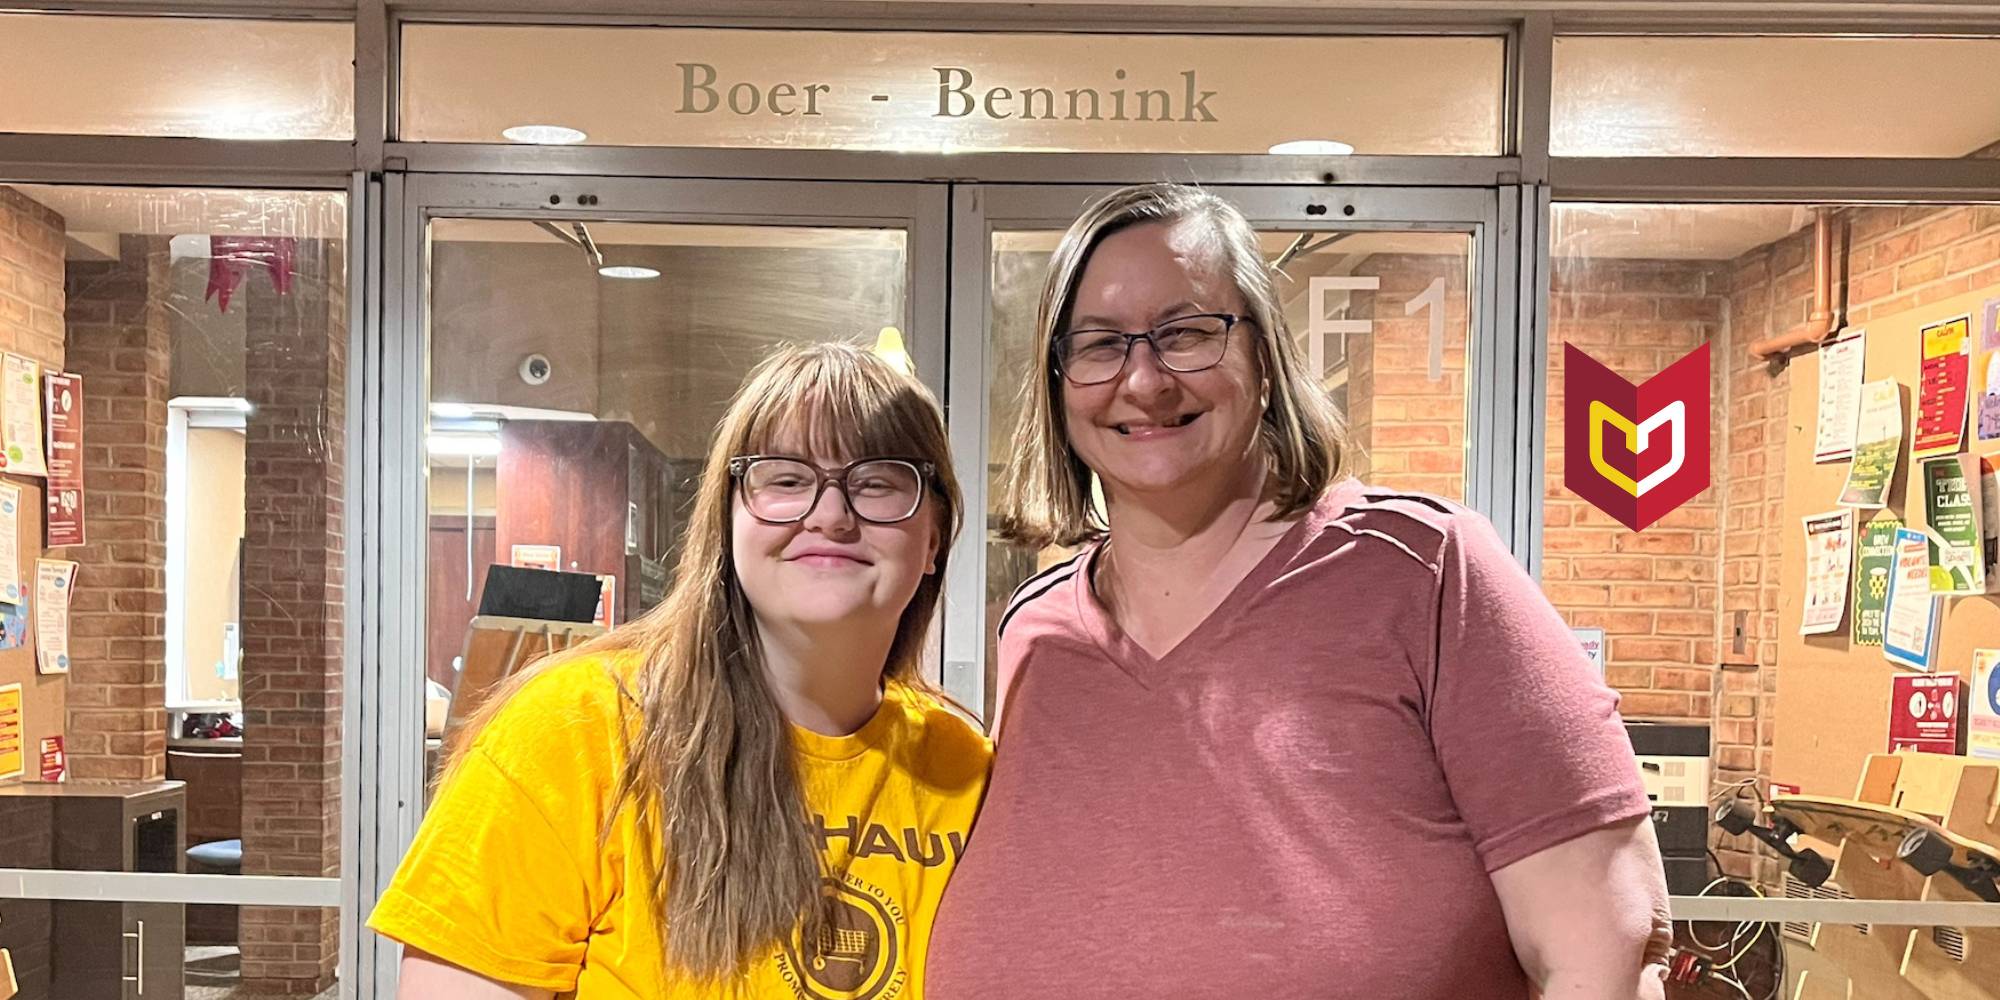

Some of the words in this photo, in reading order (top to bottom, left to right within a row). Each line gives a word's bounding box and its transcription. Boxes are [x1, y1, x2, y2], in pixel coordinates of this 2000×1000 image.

[674, 62, 831, 117] Boer
[871, 94, 889, 102] -
[932, 65, 1219, 122] Bennink
[867, 884, 885, 898] TO
[885, 896, 907, 926] YOU
